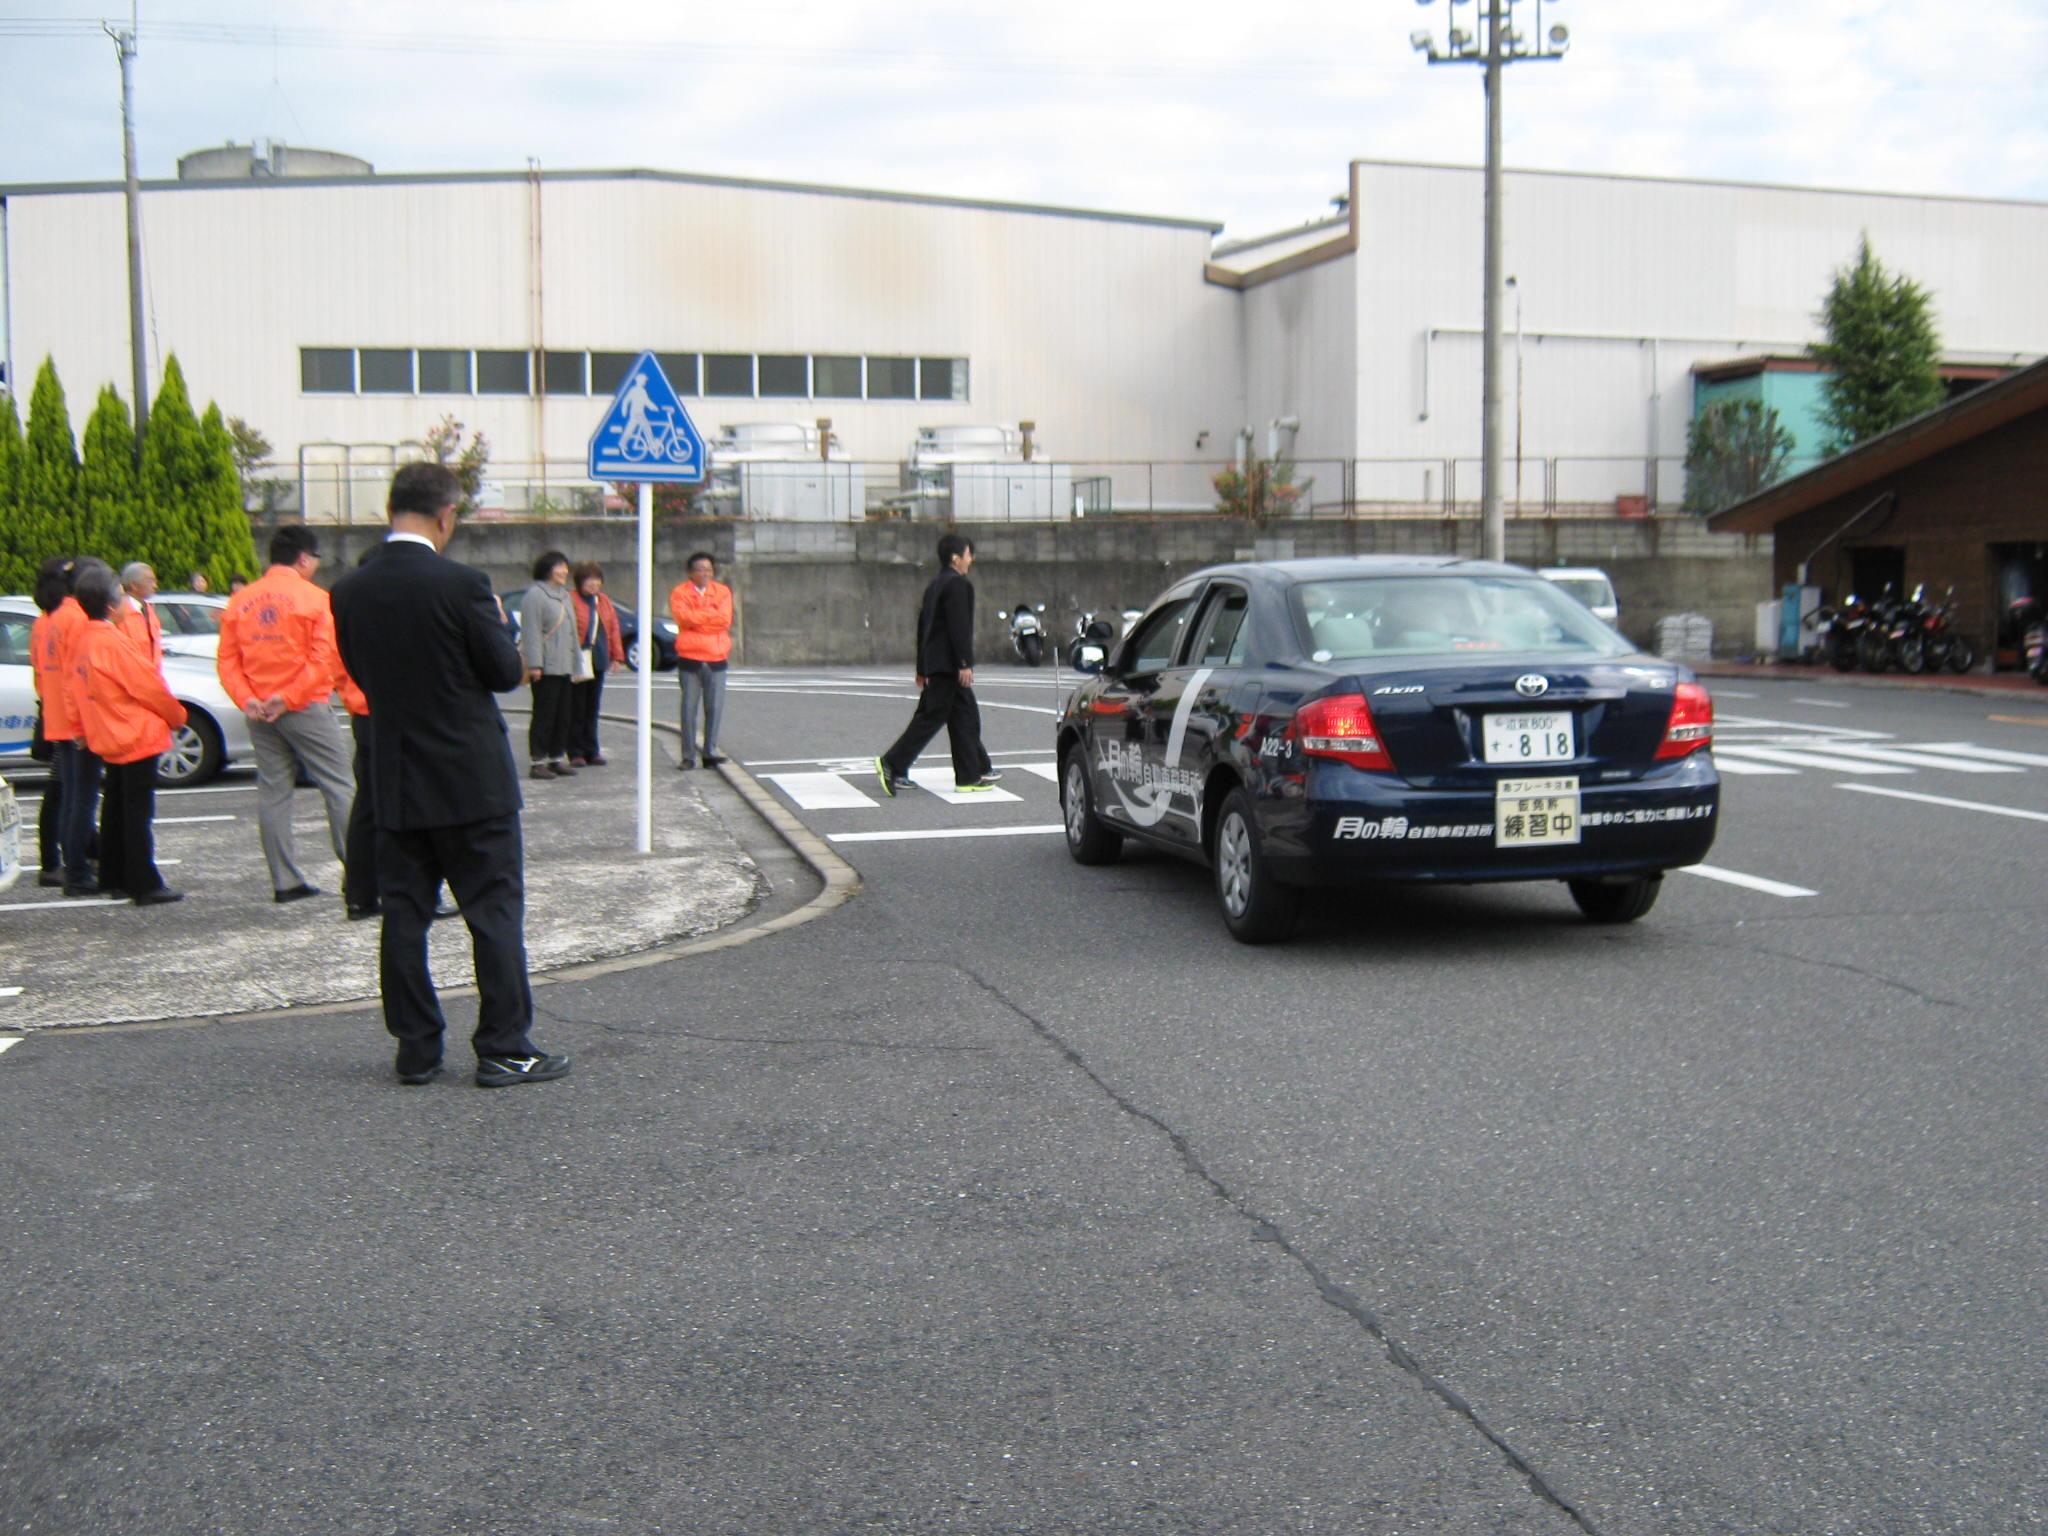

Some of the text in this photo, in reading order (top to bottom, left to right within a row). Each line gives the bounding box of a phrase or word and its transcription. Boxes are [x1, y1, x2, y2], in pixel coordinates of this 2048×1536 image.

[1260, 737, 1292, 759] A22-3
[1503, 812, 1572, 838] 練習中
